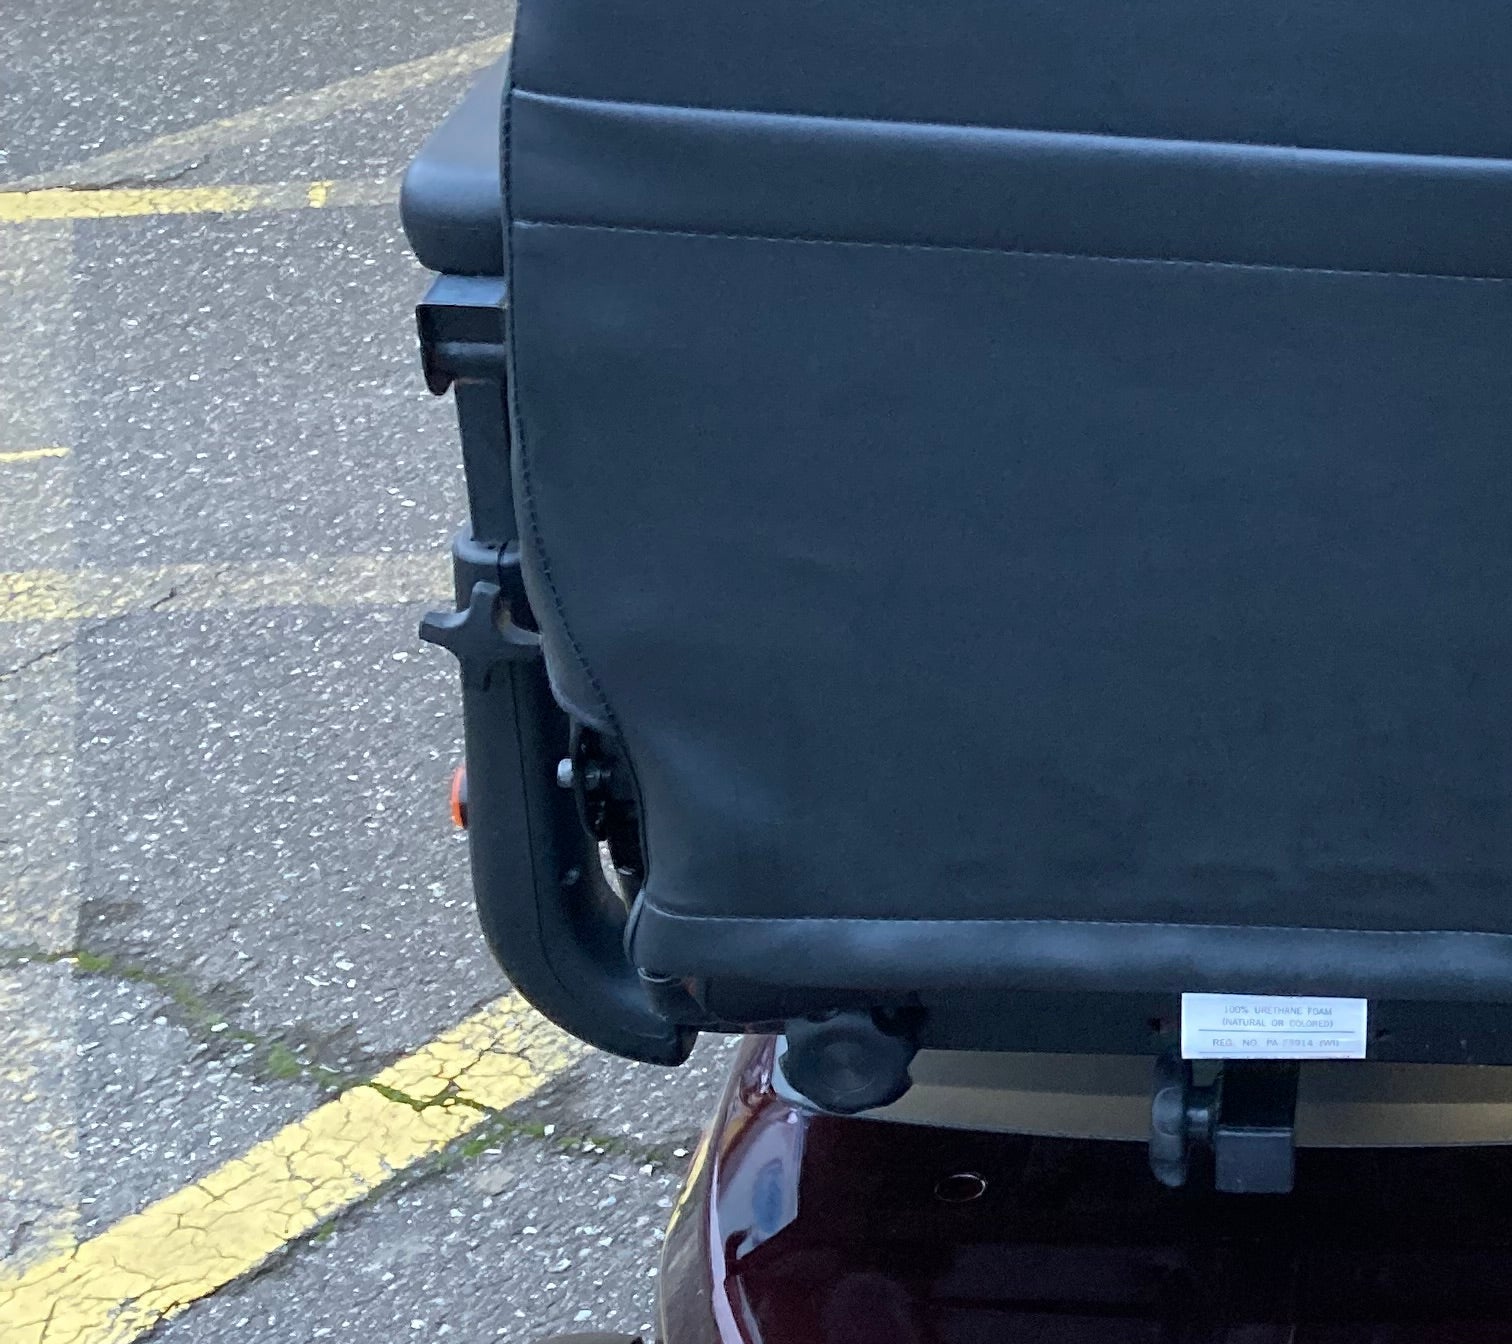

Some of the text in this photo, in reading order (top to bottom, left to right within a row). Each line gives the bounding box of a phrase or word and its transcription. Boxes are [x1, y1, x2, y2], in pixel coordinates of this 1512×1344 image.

[1254, 1006, 1302, 1015] URETHANE
[1307, 1007, 1332, 1015] FOAM
[1222, 1017, 1333, 1028] (NATURAL OR COLORED)
